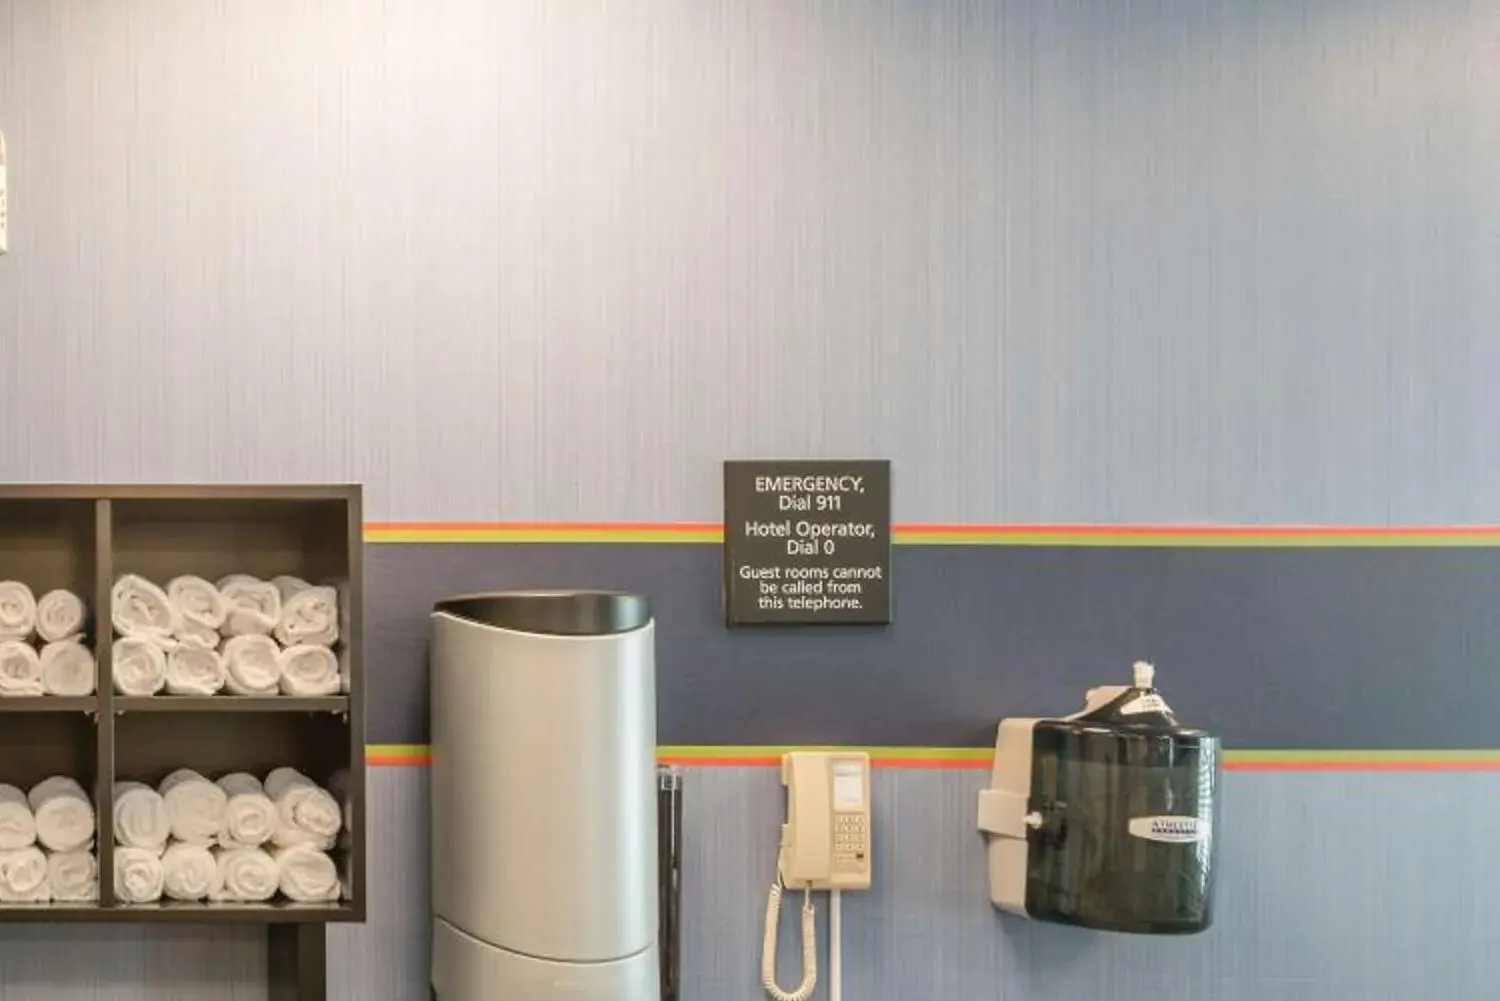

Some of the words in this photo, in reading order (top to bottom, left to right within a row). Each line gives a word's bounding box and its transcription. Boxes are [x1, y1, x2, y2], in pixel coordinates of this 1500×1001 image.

[755, 476, 865, 493] EMERGENCY,
[779, 494, 811, 511] Dial
[816, 494, 841, 511] 911
[745, 520, 791, 537] Hotel
[796, 520, 875, 540] Operator,
[787, 539, 819, 555] Dial
[823, 539, 835, 555] 0
[739, 565, 781, 579] Guest
[785, 567, 829, 579] rooms
[833, 565, 882, 579] cannot
[759, 579, 777, 594] be
[781, 579, 823, 594] called
[827, 579, 861, 594] from
[758, 595, 784, 609] this
[787, 595, 863, 612] telephone.
